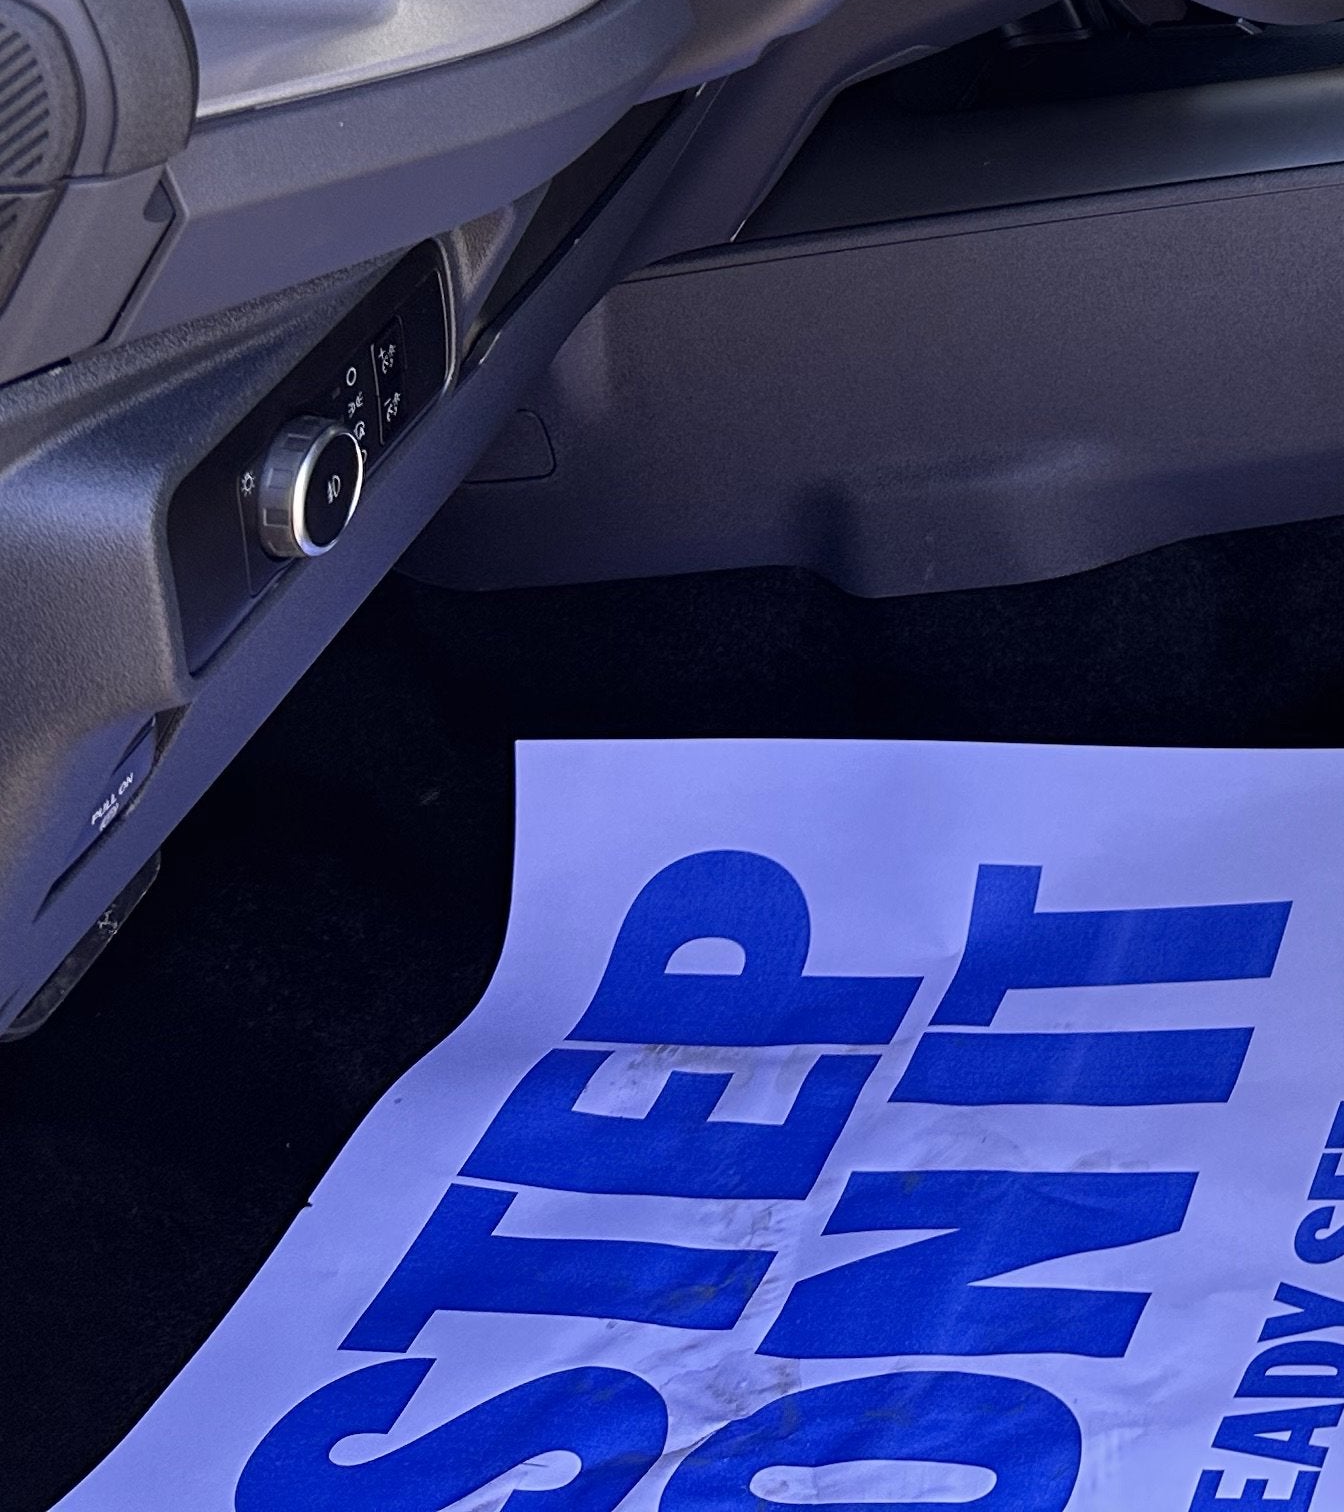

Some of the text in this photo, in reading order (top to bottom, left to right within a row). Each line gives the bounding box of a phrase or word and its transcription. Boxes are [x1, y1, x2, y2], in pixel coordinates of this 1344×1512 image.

[91, 772, 134, 826] PULL ON
[234, 849, 924, 1512] STEP
